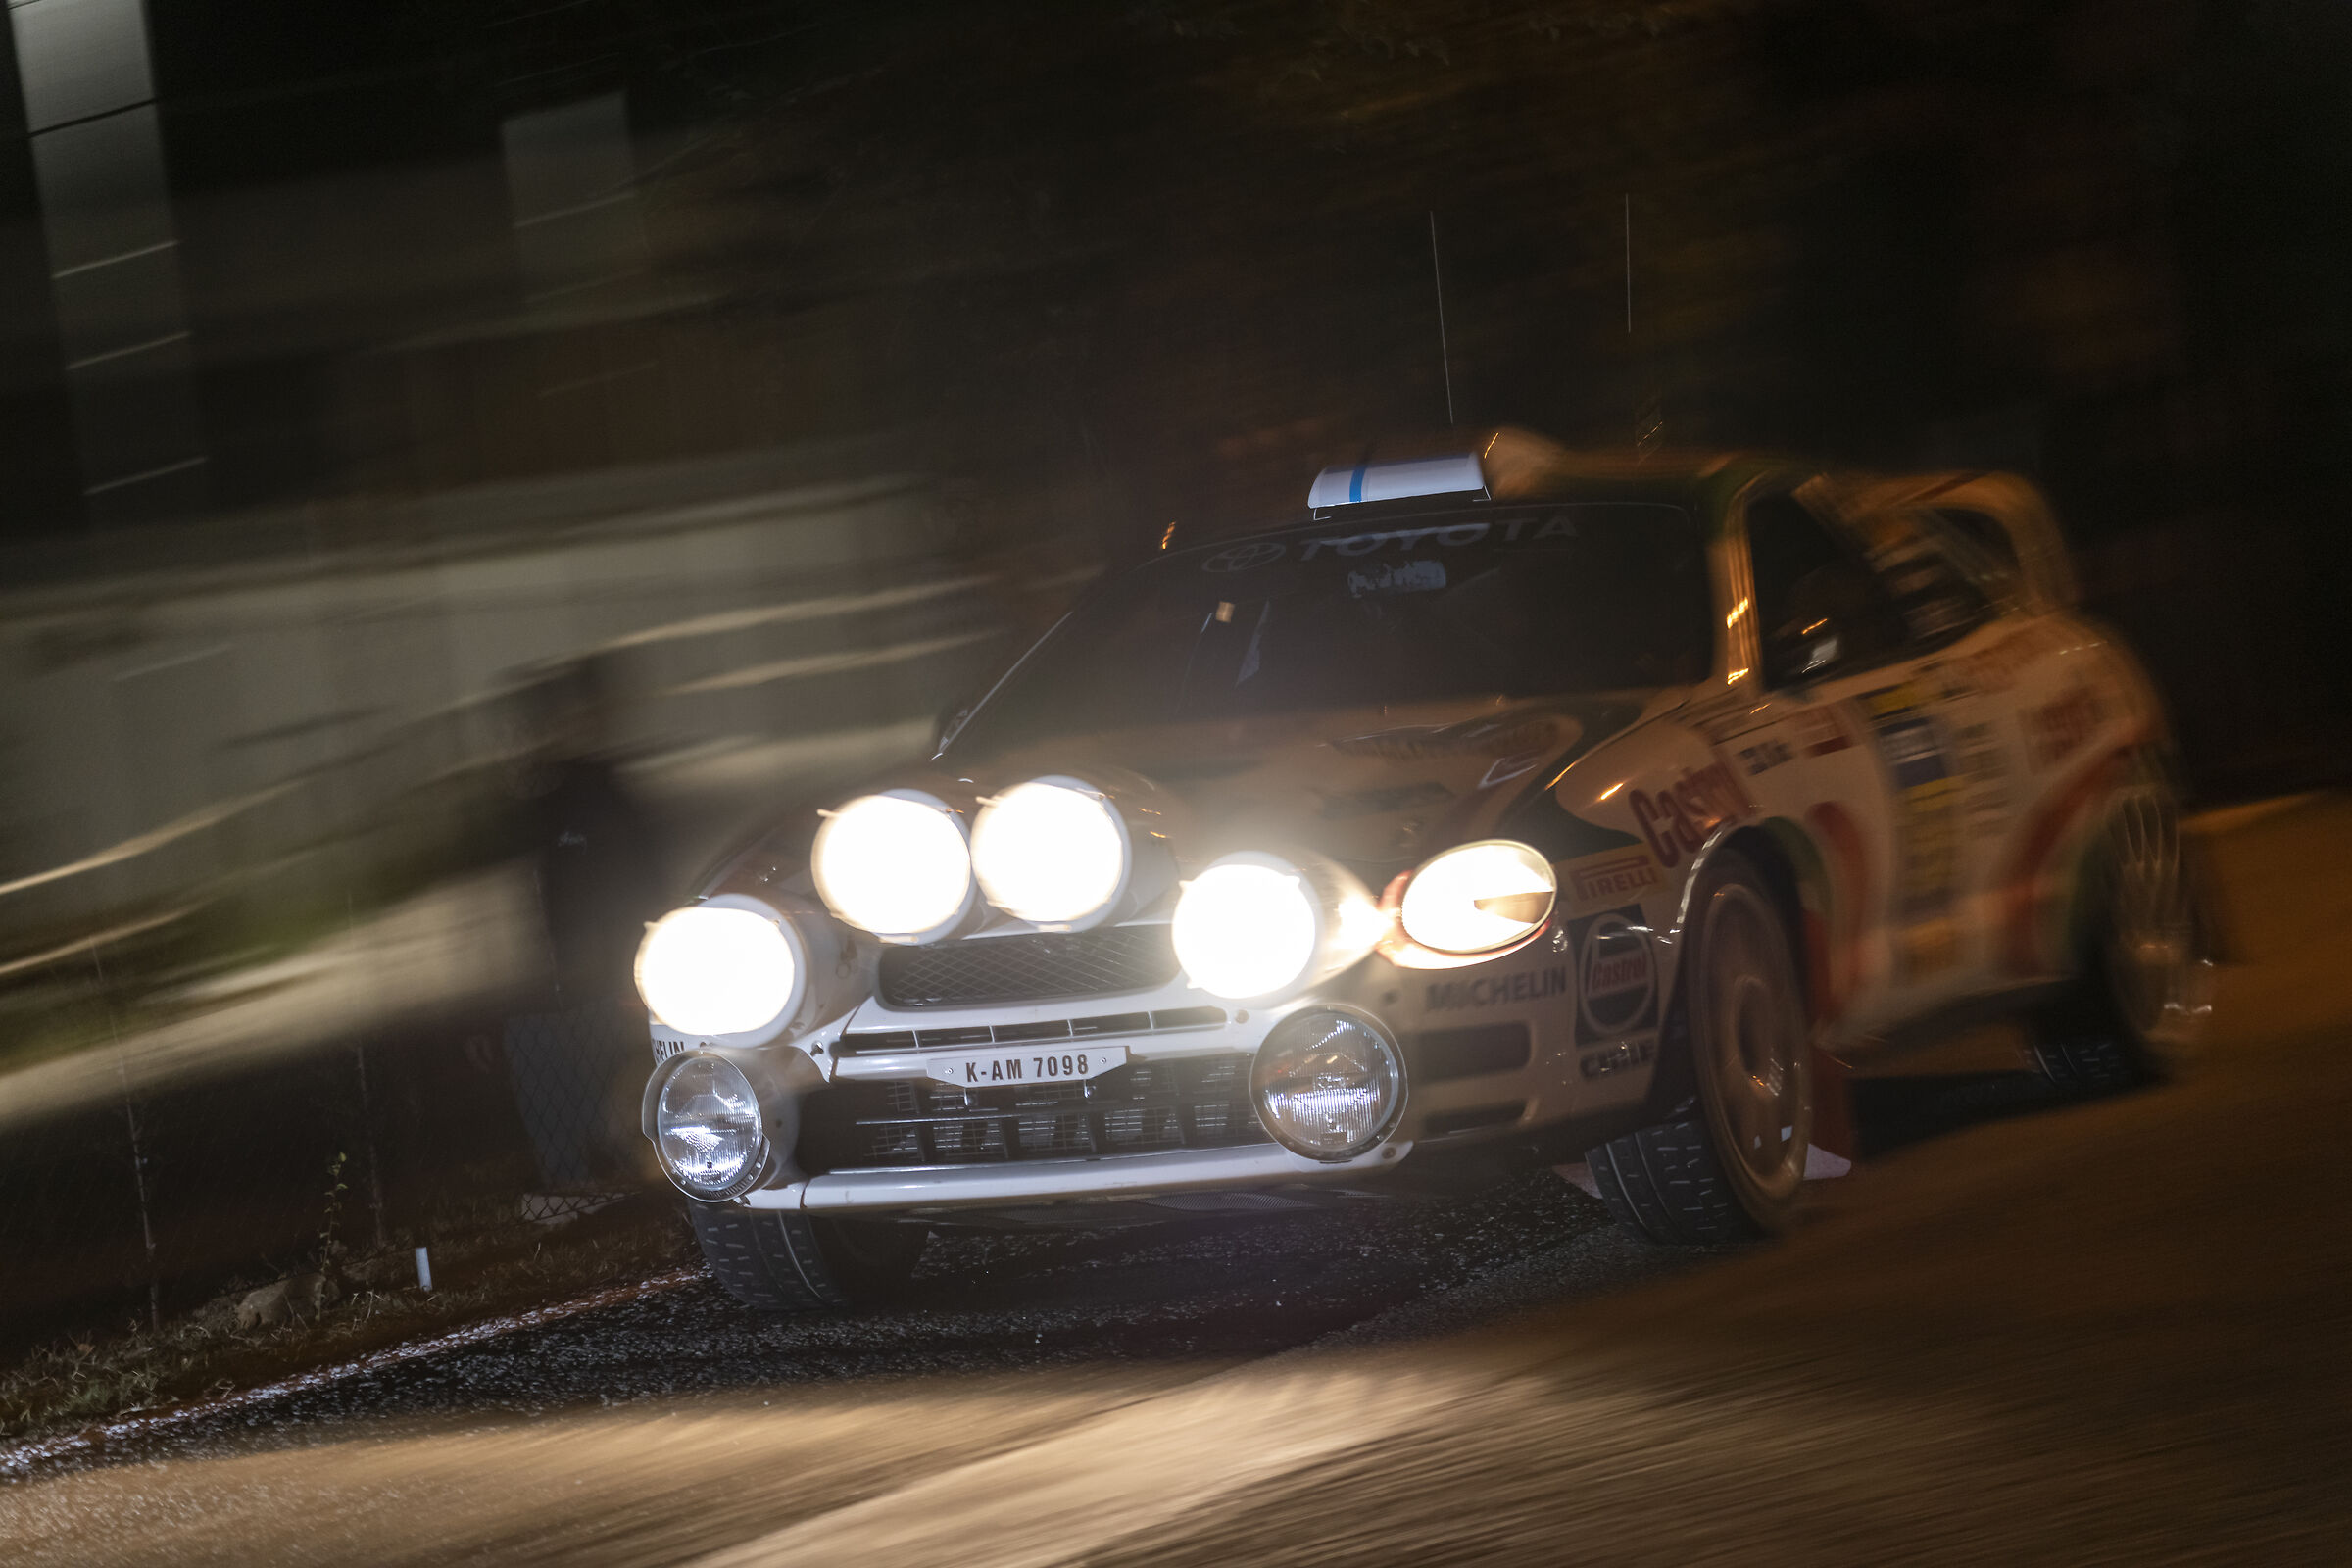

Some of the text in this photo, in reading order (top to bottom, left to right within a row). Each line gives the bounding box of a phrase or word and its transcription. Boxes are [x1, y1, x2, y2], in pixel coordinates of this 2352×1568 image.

[1299, 514, 1580, 562] TOYOTA
[1569, 855, 1659, 902] PIRELLI
[1426, 965, 1567, 1010] MICHELIN
[1592, 950, 1648, 990] Castrol
[965, 1054, 1089, 1083] K-AM 7098
